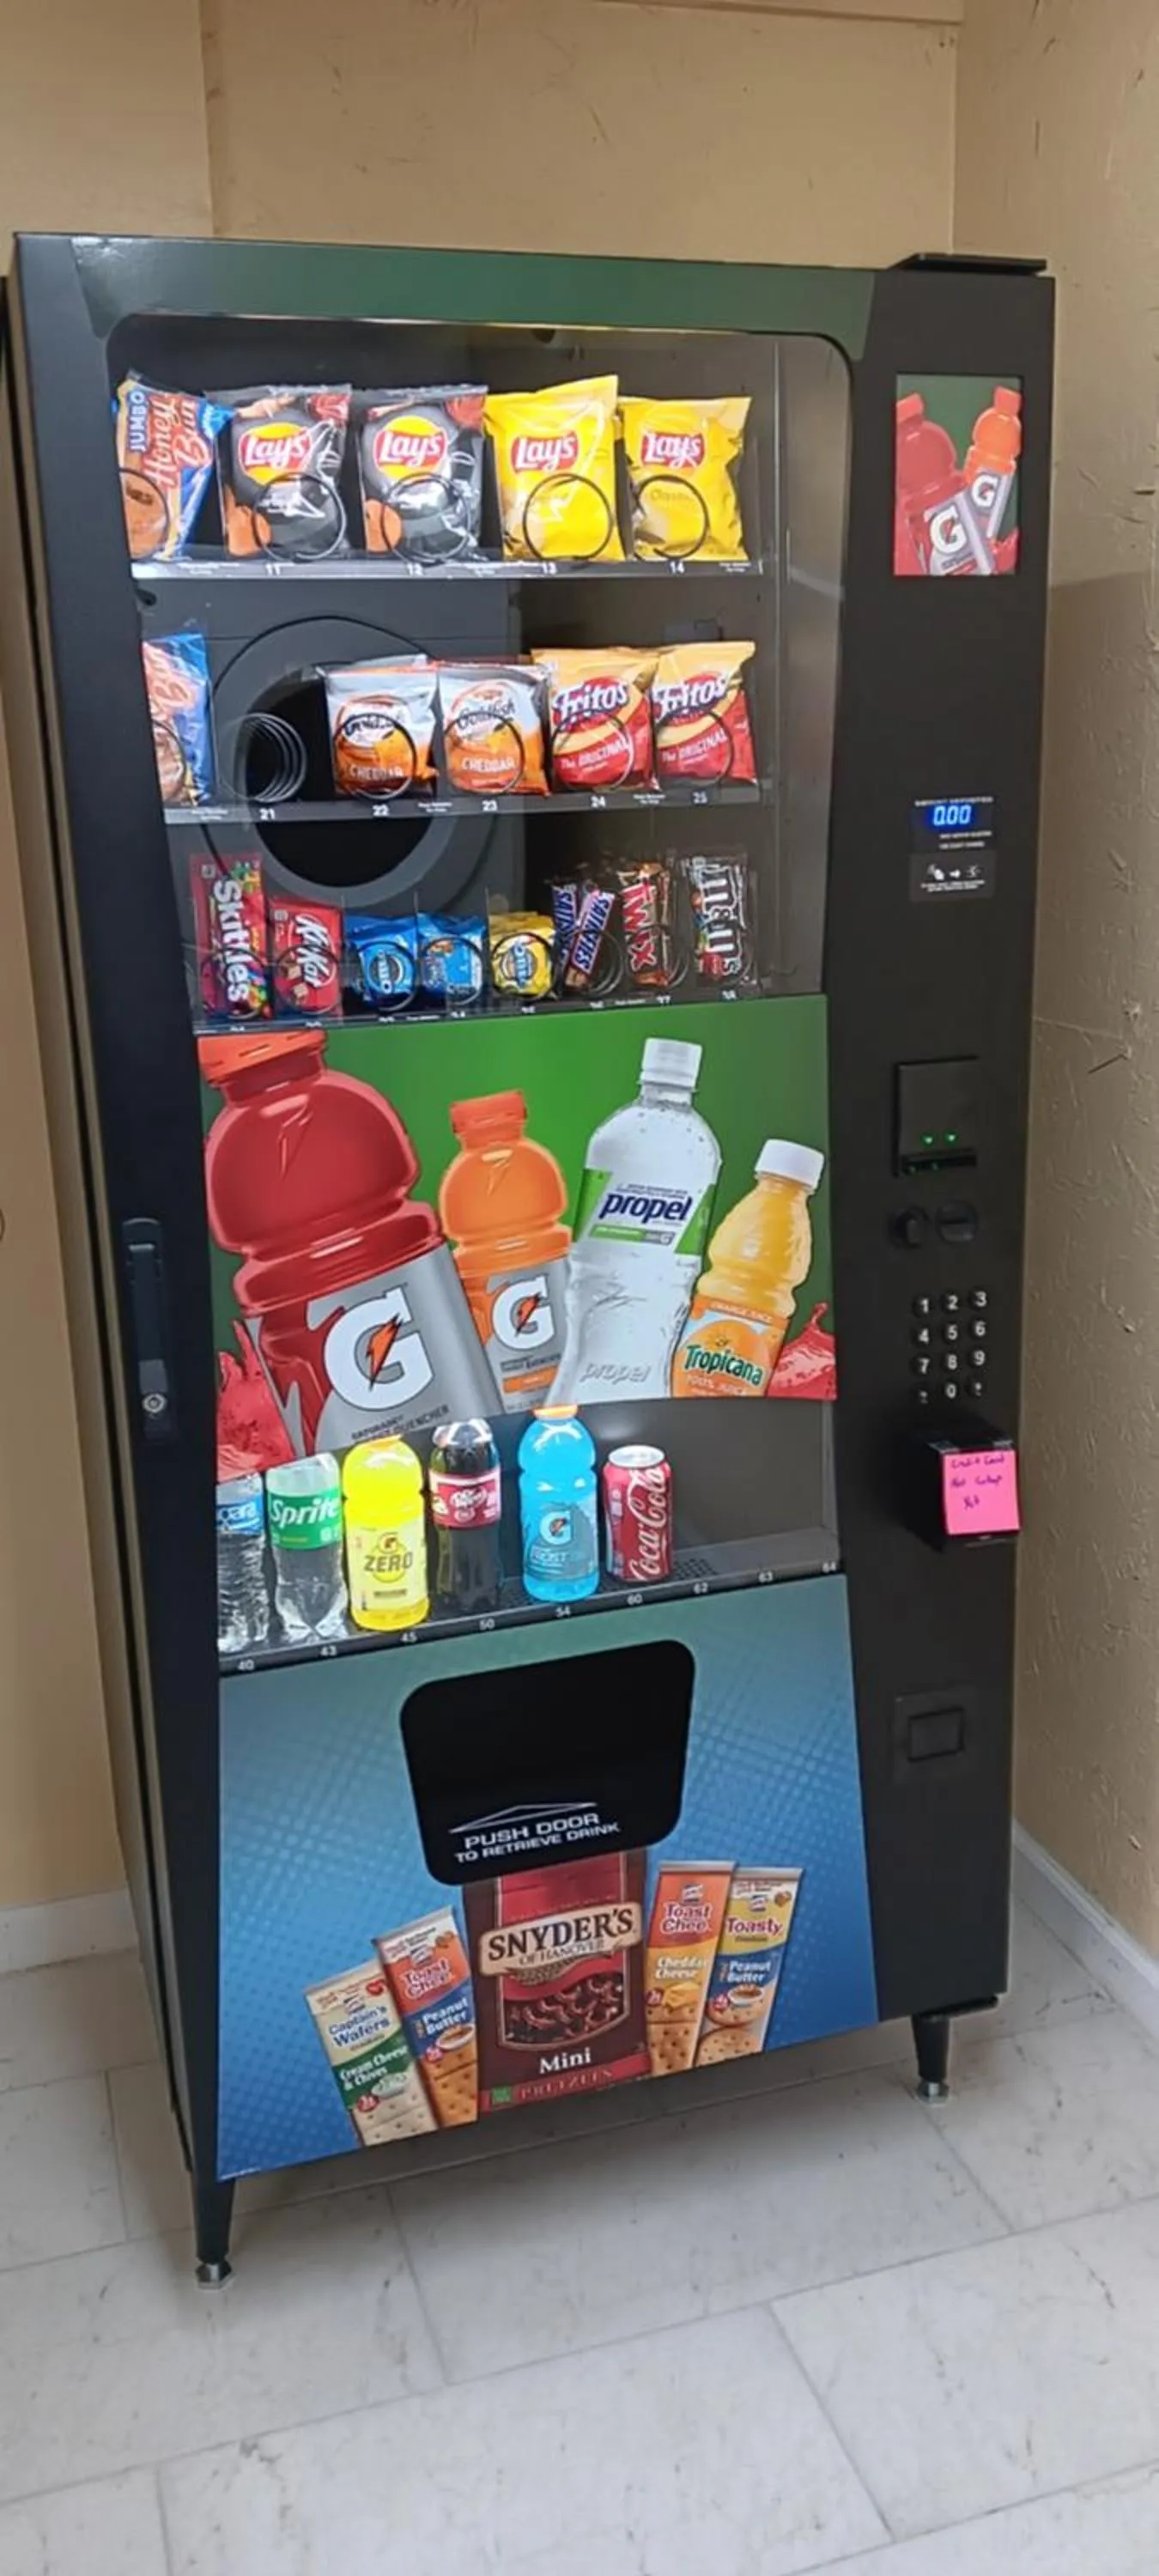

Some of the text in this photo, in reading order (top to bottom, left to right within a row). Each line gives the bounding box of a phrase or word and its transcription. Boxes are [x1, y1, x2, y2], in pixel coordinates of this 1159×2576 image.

[130, 391, 146, 452] JUMBO
[143, 396, 180, 487] Honey
[172, 399, 212, 468] Bun
[972, 474, 998, 507] G
[930, 506, 968, 554] G
[542, 562, 557, 574] 13
[670, 562, 685, 574] 14
[552, 682, 630, 731] Fritos
[652, 673, 730, 722] Fritos
[482, 799, 497, 812] 23
[591, 794, 607, 808] 24
[694, 791, 708, 805] 25
[261, 808, 276, 821] 21
[373, 805, 389, 817] 22
[214, 880, 250, 1002] Skittles
[598, 1193, 693, 1224] propel
[492, 1275, 555, 1349] G
[920, 1291, 987, 1314] 1 2 3
[919, 1321, 986, 1344] 4 5 6
[324, 1286, 434, 1411] G
[684, 1344, 763, 1386] Tropicana
[919, 1350, 985, 1374] 7 8 9
[580, 1363, 651, 1385] propel
[946, 1383, 956, 1399] 0
[539, 1510, 572, 1545] G
[364, 1552, 414, 1573] ZERO
[822, 1562, 837, 1573] 64
[759, 1571, 773, 1583] 63
[627, 1594, 642, 1605] 60
[694, 1583, 708, 1595] 62
[556, 1607, 571, 1617] 54
[479, 1619, 495, 1631] 50
[400, 1632, 417, 1643] 45
[320, 1646, 337, 1656] 43
[238, 1660, 254, 1671] 40
[455, 1822, 621, 1863] TO RETRIEVE DRINK
[464, 1813, 600, 1849] PUSH DOOR
[488, 1908, 634, 1961] SNYDER'S
[727, 1917, 783, 1935] Toasty
[519, 1953, 537, 1966] OF
[422, 1997, 469, 2023] Peanut
[333, 2018, 390, 2048] Wafers
[539, 2046, 592, 2075] Mini
